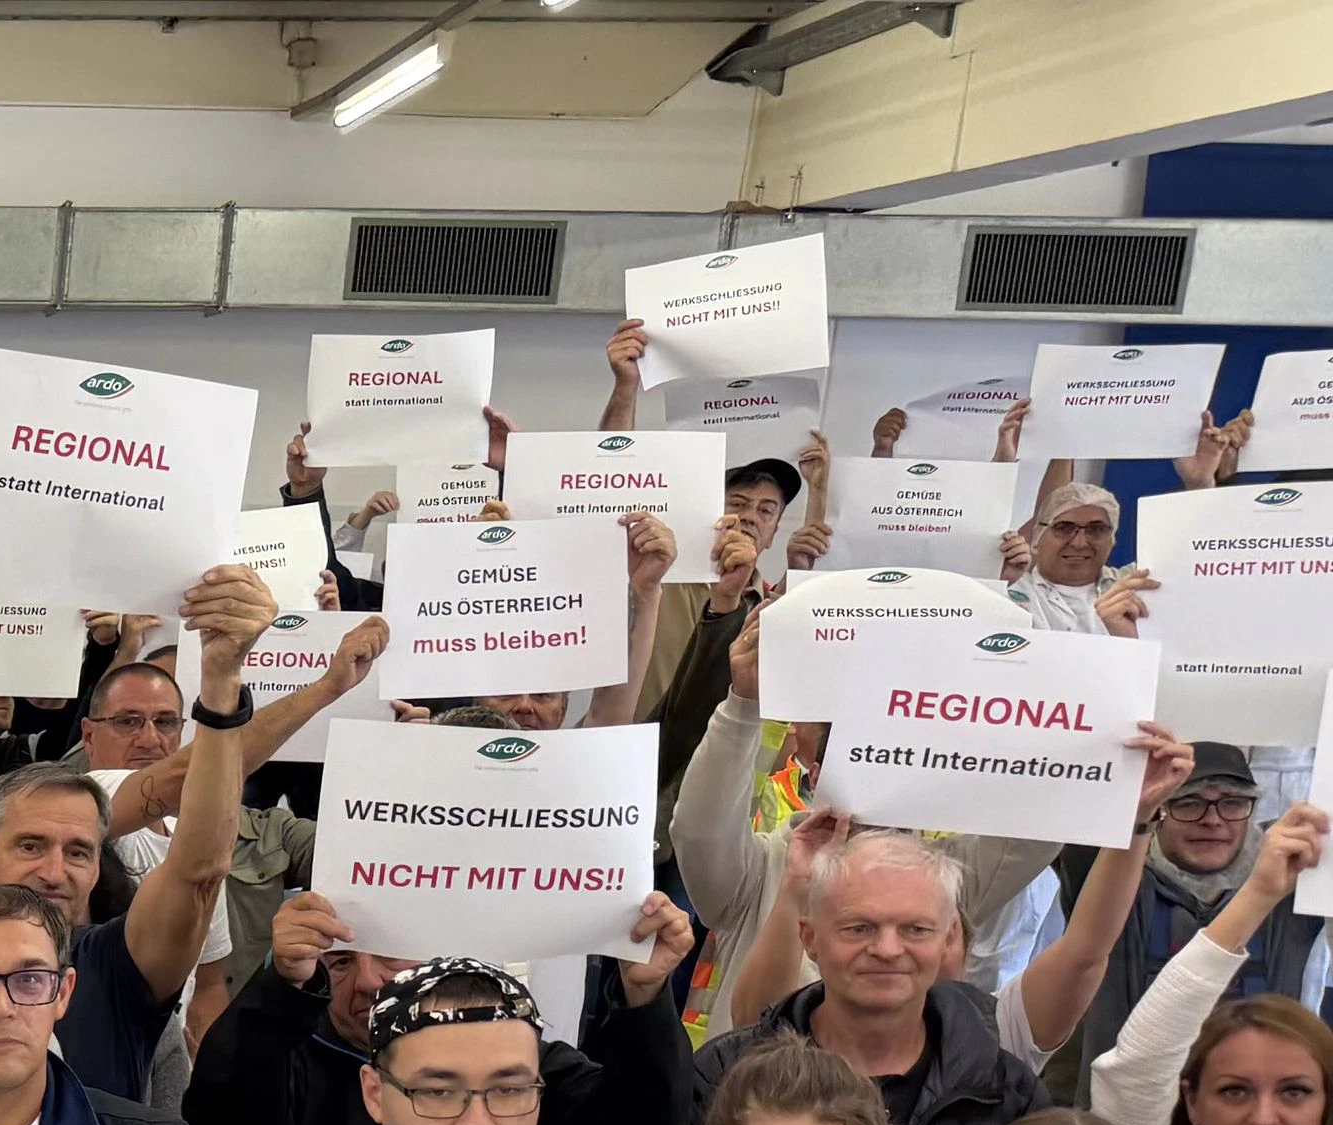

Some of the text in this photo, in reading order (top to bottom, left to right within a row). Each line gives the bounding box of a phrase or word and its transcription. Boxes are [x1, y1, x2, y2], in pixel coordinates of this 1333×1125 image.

[664, 283, 782, 309] WERKSSCHLIESSUNG
[667, 300, 779, 327] NICHT MIT UNS!!
[88, 372, 123, 393] ardo
[349, 371, 442, 386] REGIONAL
[1067, 379, 1175, 389] WERKSSCHLIESSUNG
[346, 395, 443, 407] statt International
[704, 396, 778, 410] REGIONAL
[1065, 395, 1169, 405] NICHT MIT UNS!!
[12, 425, 169, 471] REGIONAL
[441, 480, 486, 490] GEMÜSE
[561, 473, 667, 489] REGIONAL
[46, 481, 164, 511] International
[418, 498, 439, 506] AUS
[897, 491, 941, 500] GEMÜSE
[557, 503, 667, 515] statt International
[871, 505, 962, 517] AUS ÖSTERREICH
[458, 565, 536, 584] GEMÜSE
[1195, 562, 1254, 576] NICHT
[1262, 561, 1295, 575] MIT
[418, 594, 582, 616] AUS ÖSTERREICH
[812, 608, 972, 617] WERKSSCHLIESSUNG
[7, 624, 43, 635] UNS!!
[414, 626, 586, 653] muss bleiben!
[1176, 664, 1301, 674] statt International
[887, 690, 1093, 731] REGIONAL
[484, 740, 527, 756] ardo
[849, 745, 1112, 782] statt International
[345, 800, 638, 828] WERKSSCHLIESSUNG
[352, 862, 624, 891] NICHT MIT UNS!!
